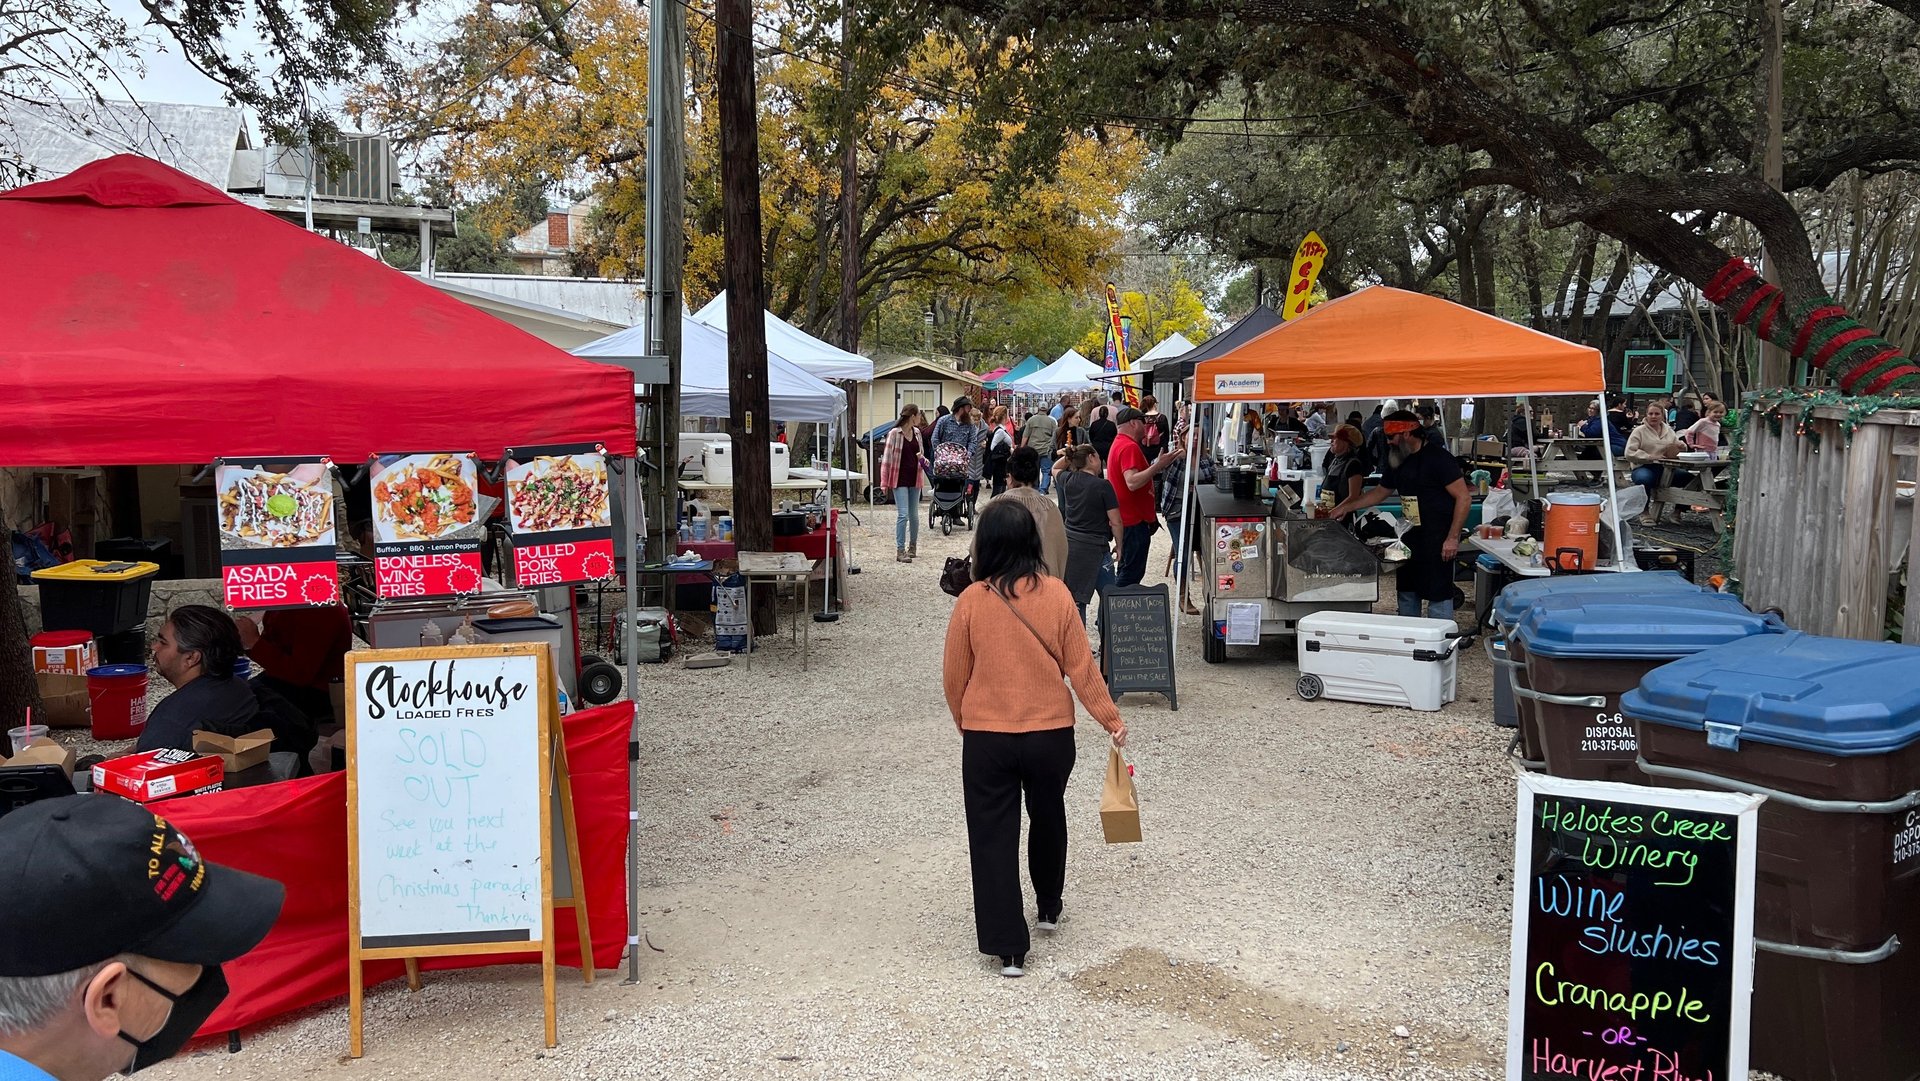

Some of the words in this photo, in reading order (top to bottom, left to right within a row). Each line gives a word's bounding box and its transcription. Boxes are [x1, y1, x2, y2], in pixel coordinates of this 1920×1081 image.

[454, 543, 479, 551] Pepper
[516, 543, 576, 560] PULLED
[378, 553, 461, 570] BONELESS
[517, 557, 558, 573] PORK
[227, 565, 297, 584] ASADA
[379, 569, 424, 583] WING
[518, 570, 562, 585] FRIES
[227, 582, 288, 602] FRIES
[379, 582, 426, 597] FRIES
[1110, 598, 1142, 610] KOREAN
[1143, 596, 1164, 610] TACOS
[1112, 624, 1130, 633] BEEF
[1120, 656, 1136, 667] PORK
[1138, 656, 1160, 668] BELLY
[1149, 672, 1168, 681] SALE
[365, 659, 528, 719] Stockhouse
[396, 710, 451, 719] LOADED
[1596, 712, 1623, 724] C-6
[1585, 726, 1635, 738] DISPOSAL
[396, 728, 487, 771] SOLD
[1581, 739, 1638, 751] 210-375-006
[404, 774, 480, 815] OUT
[378, 809, 415, 831] See
[429, 816, 454, 842] you
[467, 808, 505, 831] next
[1541, 800, 1643, 834] Helotes
[1650, 810, 1732, 840] Creek
[150, 833, 166, 855] ALL
[387, 838, 423, 859] week
[436, 835, 453, 852] at
[464, 831, 498, 853] the
[148, 858, 160, 879] TO
[1583, 834, 1698, 886] Winery
[377, 873, 460, 902] Christmas
[1539, 874, 1624, 922] Wine
[1536, 961, 1710, 1023] Cranapple
[1533, 1037, 1645, 1081] Harvest
